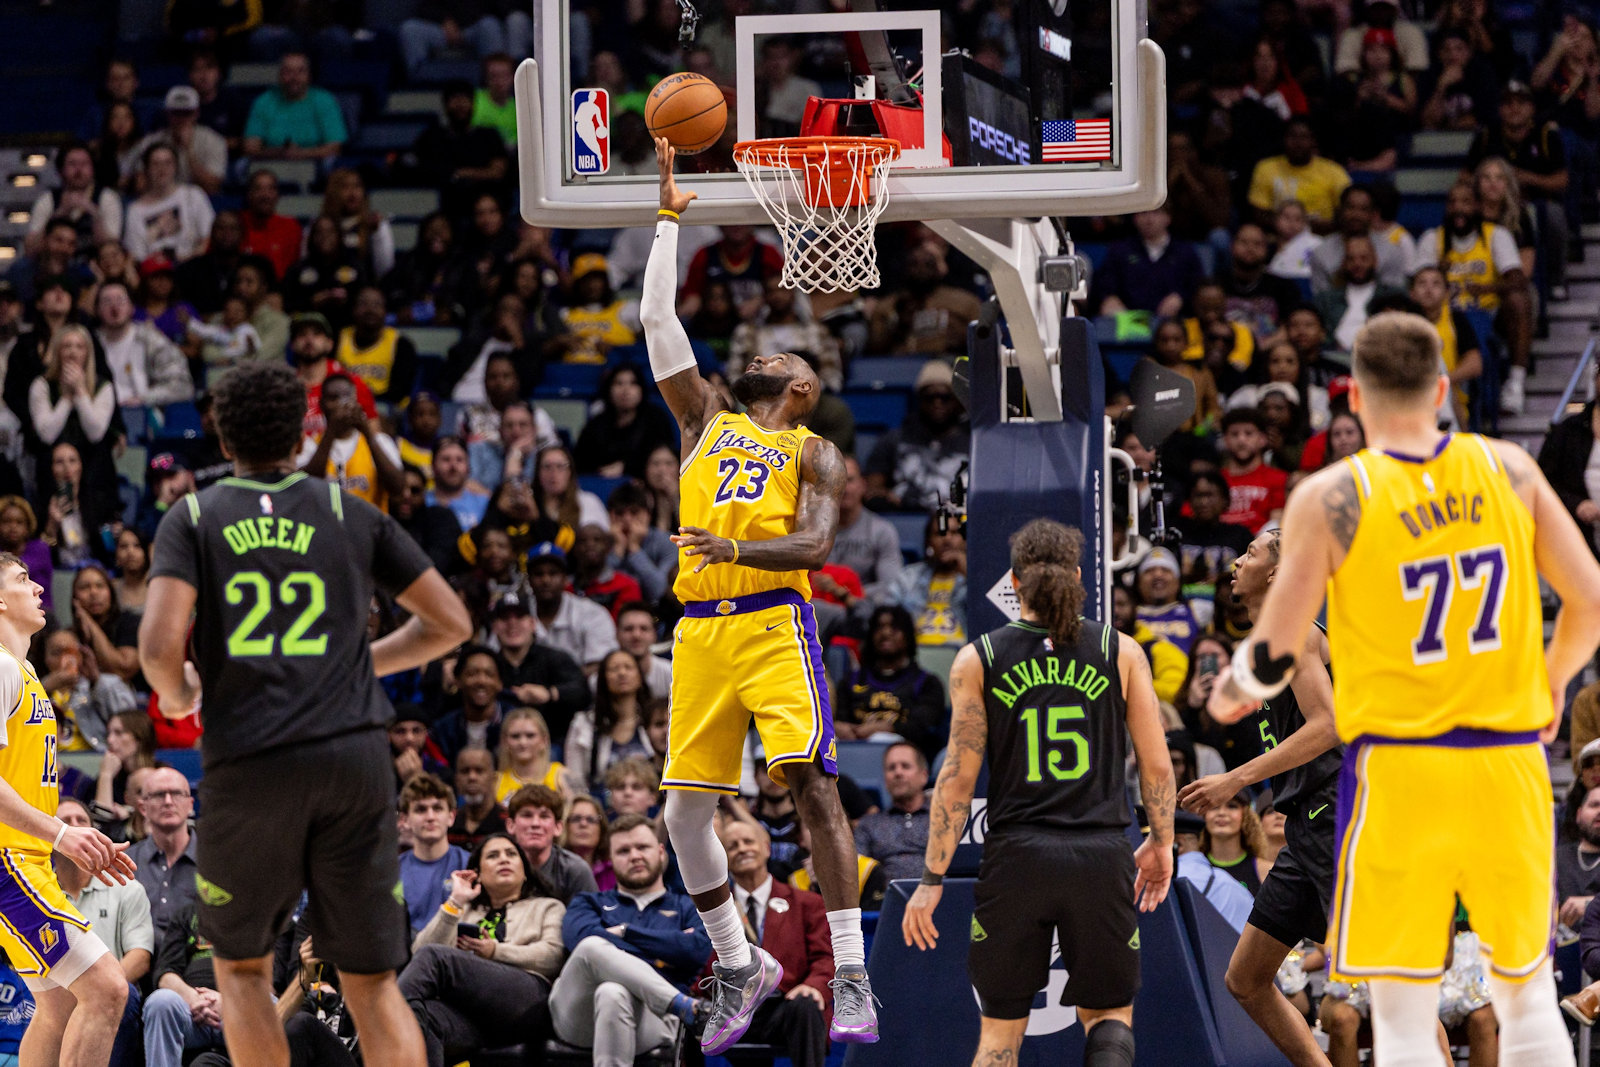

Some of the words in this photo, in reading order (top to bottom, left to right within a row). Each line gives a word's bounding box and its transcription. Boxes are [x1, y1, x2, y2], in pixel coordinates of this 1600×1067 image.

[578, 155, 596, 169] NBA
[969, 116, 1031, 165] PORSCHE
[704, 429, 791, 471] LAKERS
[713, 457, 770, 507] 23
[223, 517, 316, 555] QUEEN
[225, 571, 328, 656] 22
[1398, 543, 1509, 666] 77
[991, 656, 1110, 709] ALVARADO
[1020, 705, 1090, 782] 15
